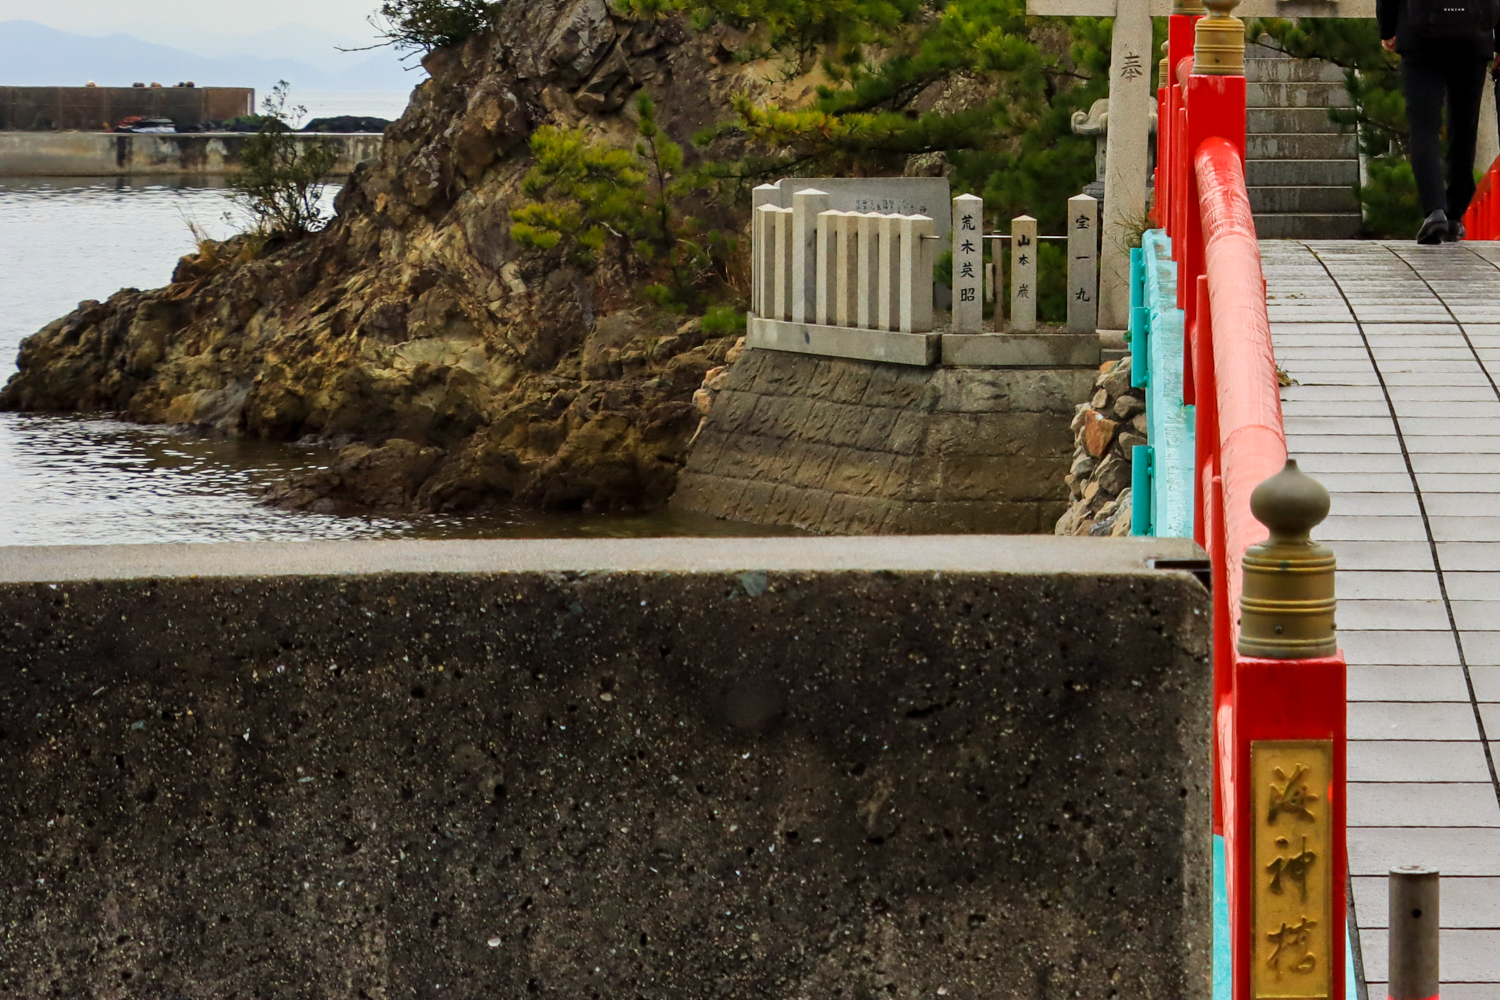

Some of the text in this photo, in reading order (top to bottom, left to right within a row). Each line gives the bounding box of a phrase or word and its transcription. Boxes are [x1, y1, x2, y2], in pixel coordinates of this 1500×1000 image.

[1120, 51, 1143, 83] 奉
[960, 214, 976, 303] 荒木英昭
[1075, 214, 1091, 303] 宝一丸
